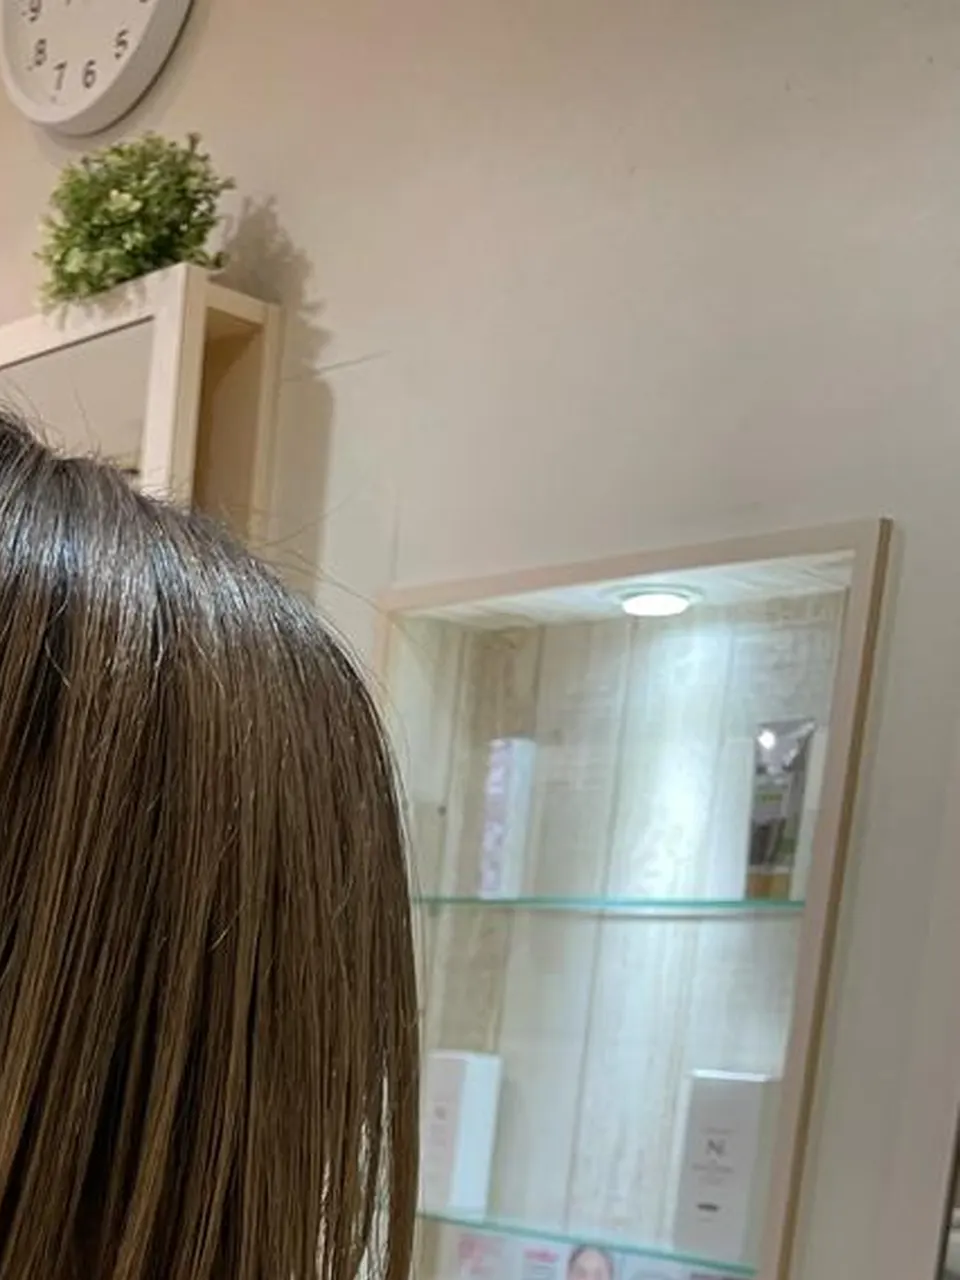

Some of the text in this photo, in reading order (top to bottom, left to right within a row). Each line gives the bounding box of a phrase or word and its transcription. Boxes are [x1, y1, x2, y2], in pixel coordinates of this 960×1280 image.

[33, 38, 48, 67] 8
[114, 29, 128, 60] 5
[53, 60, 68, 91] 7
[82, 60, 96, 89] 6
